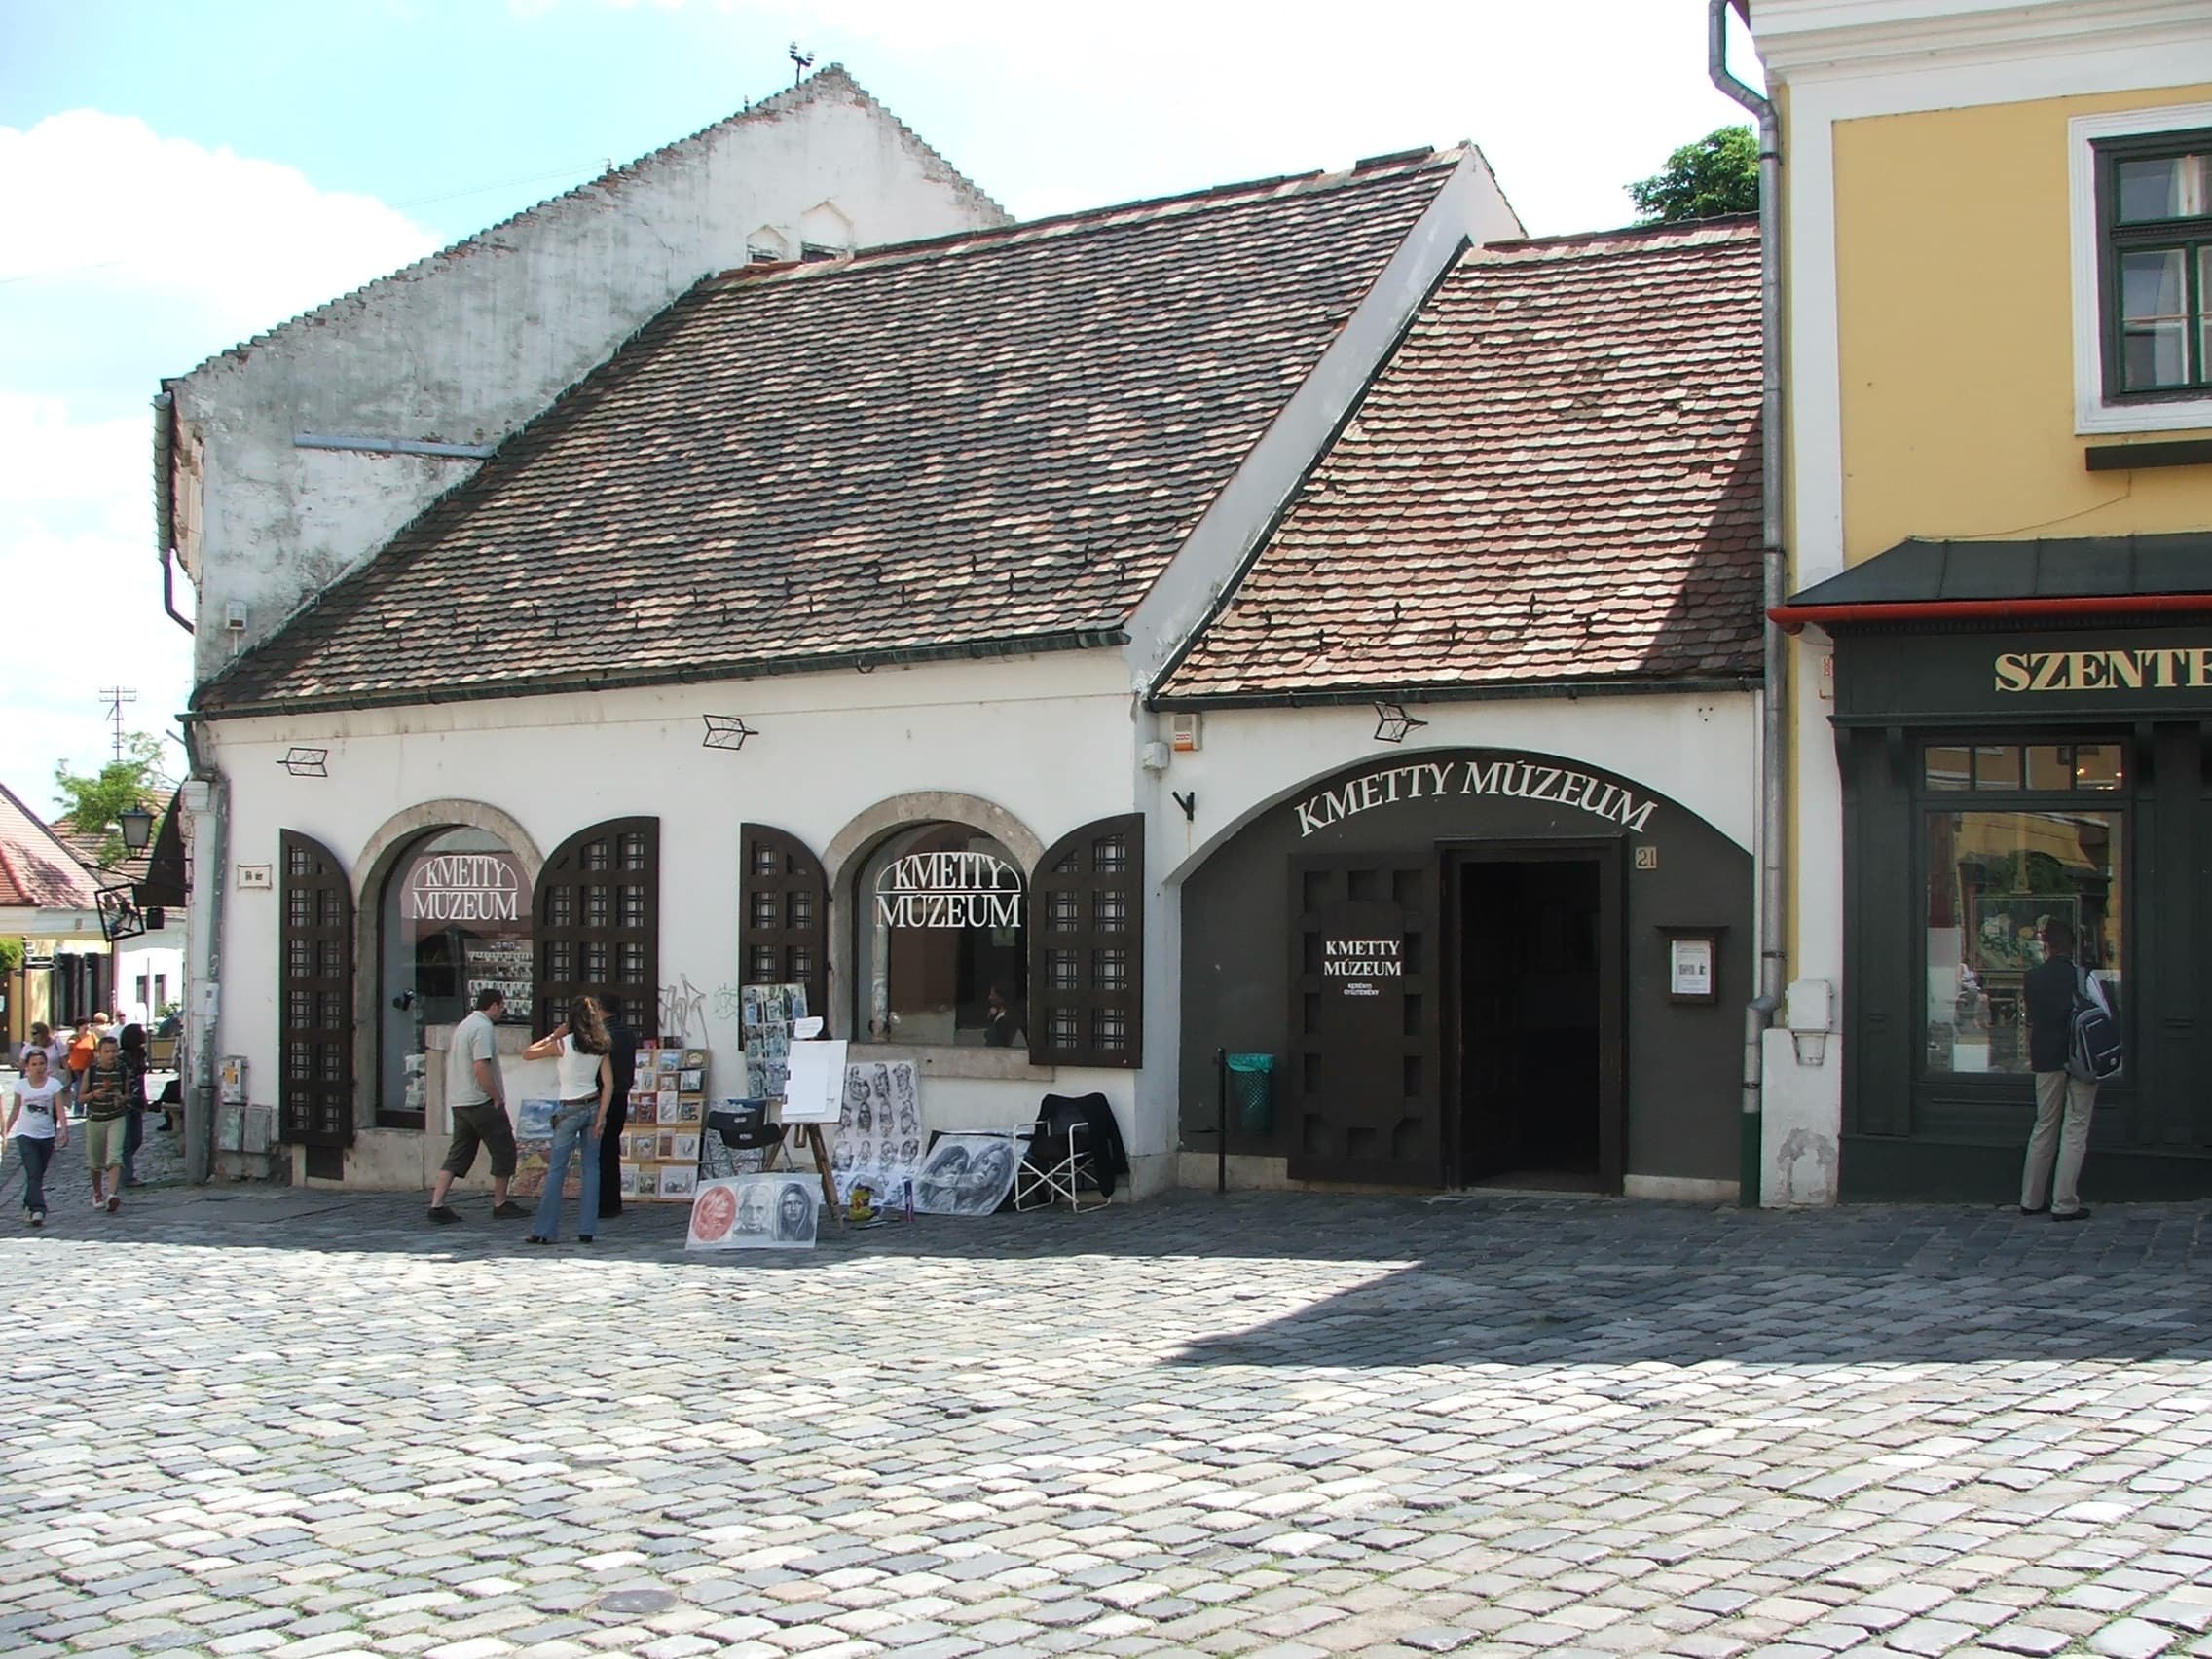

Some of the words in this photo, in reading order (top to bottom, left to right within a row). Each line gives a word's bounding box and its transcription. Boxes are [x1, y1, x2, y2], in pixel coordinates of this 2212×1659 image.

[1294, 762, 1454, 837] KMETTY
[1459, 760, 1658, 833] MÚZEUM
[1638, 848, 1655, 866] 21
[424, 855, 506, 887] KMETTY
[893, 852, 1007, 890] KMETTY
[1326, 940, 1400, 955] KMETTY
[1324, 958, 1402, 976] MÚZEUM
